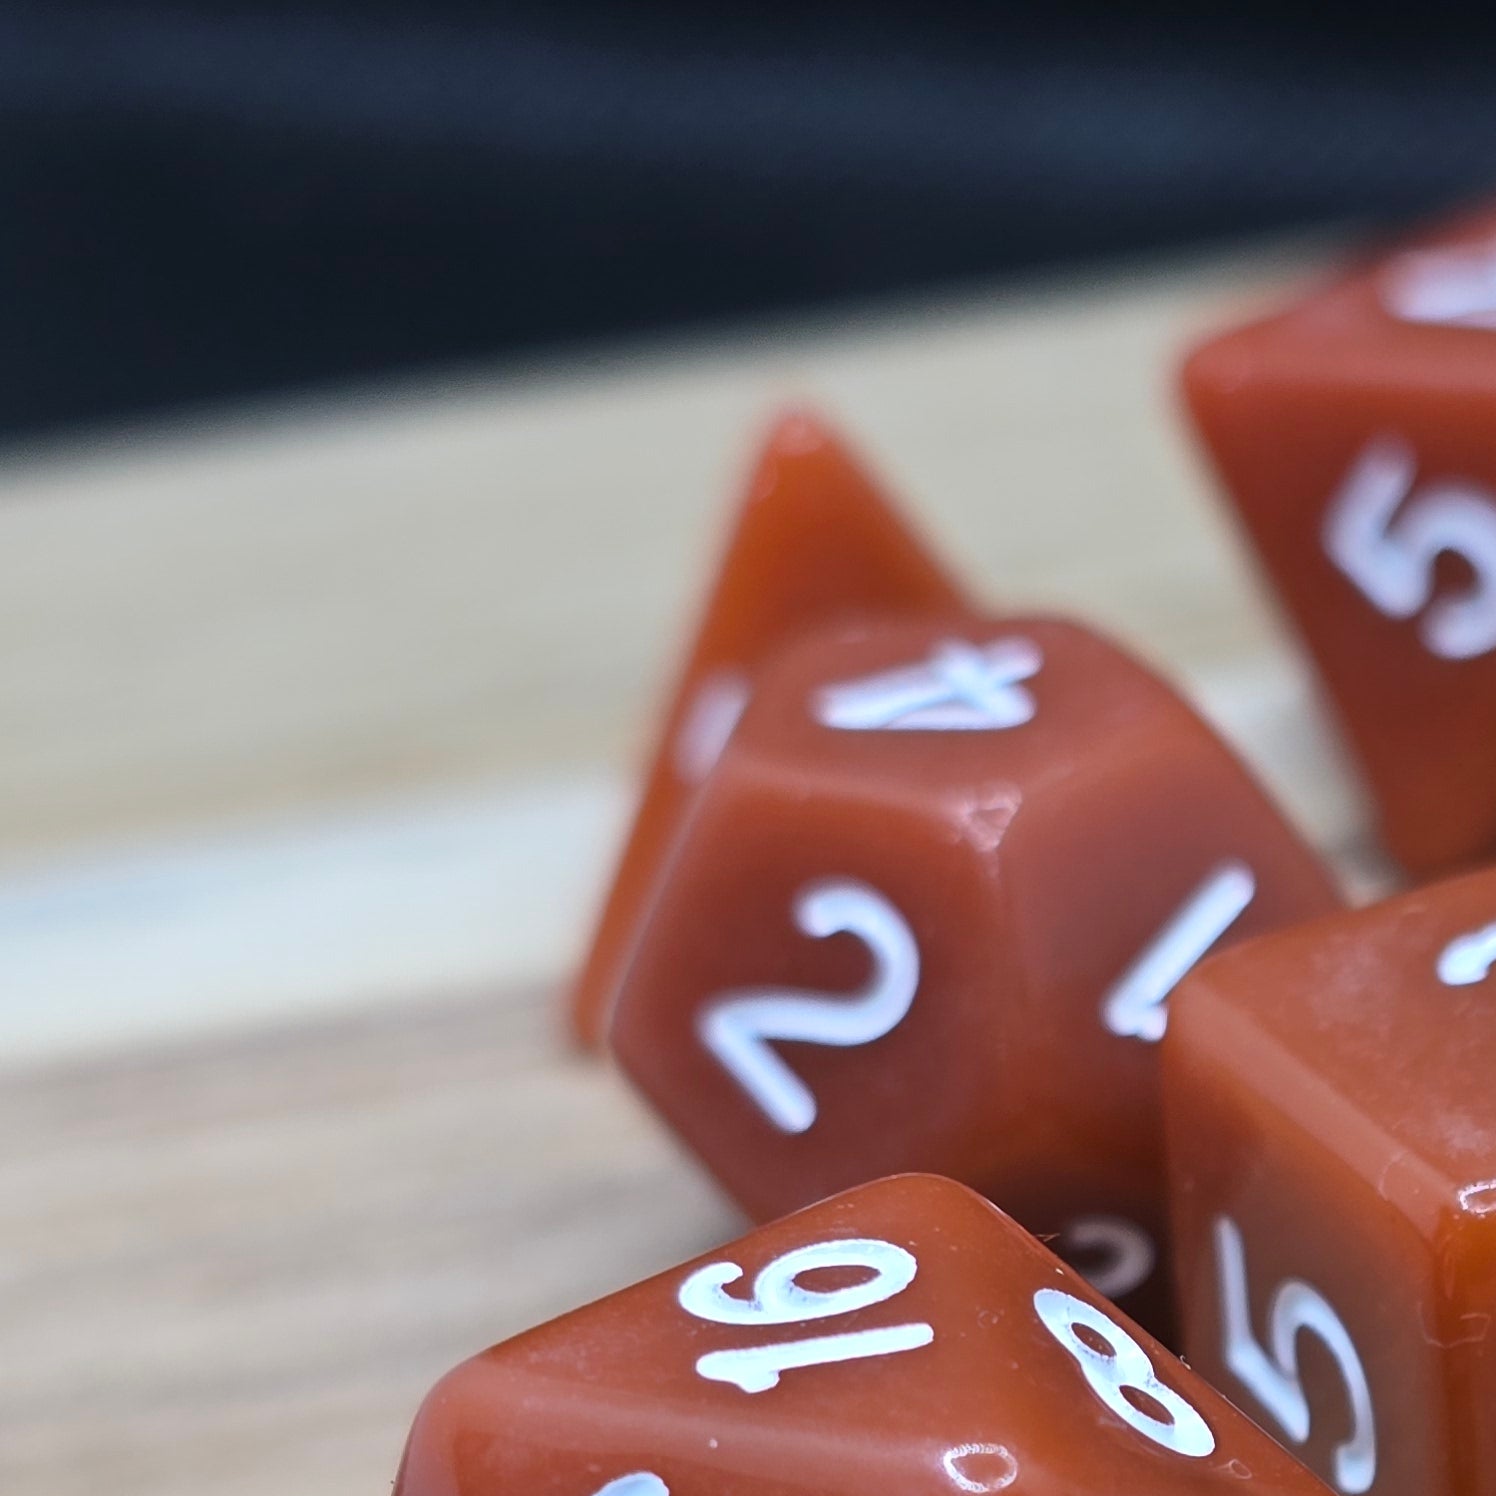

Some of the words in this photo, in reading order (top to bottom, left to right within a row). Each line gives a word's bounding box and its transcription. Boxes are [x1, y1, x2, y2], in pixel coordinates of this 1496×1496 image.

[812, 636, 1042, 732] 4
[700, 878, 920, 1134] 2
[678, 1238, 936, 1394] 16
[1033, 1288, 1216, 1457] 8
[1212, 1212, 1376, 1496] 5
